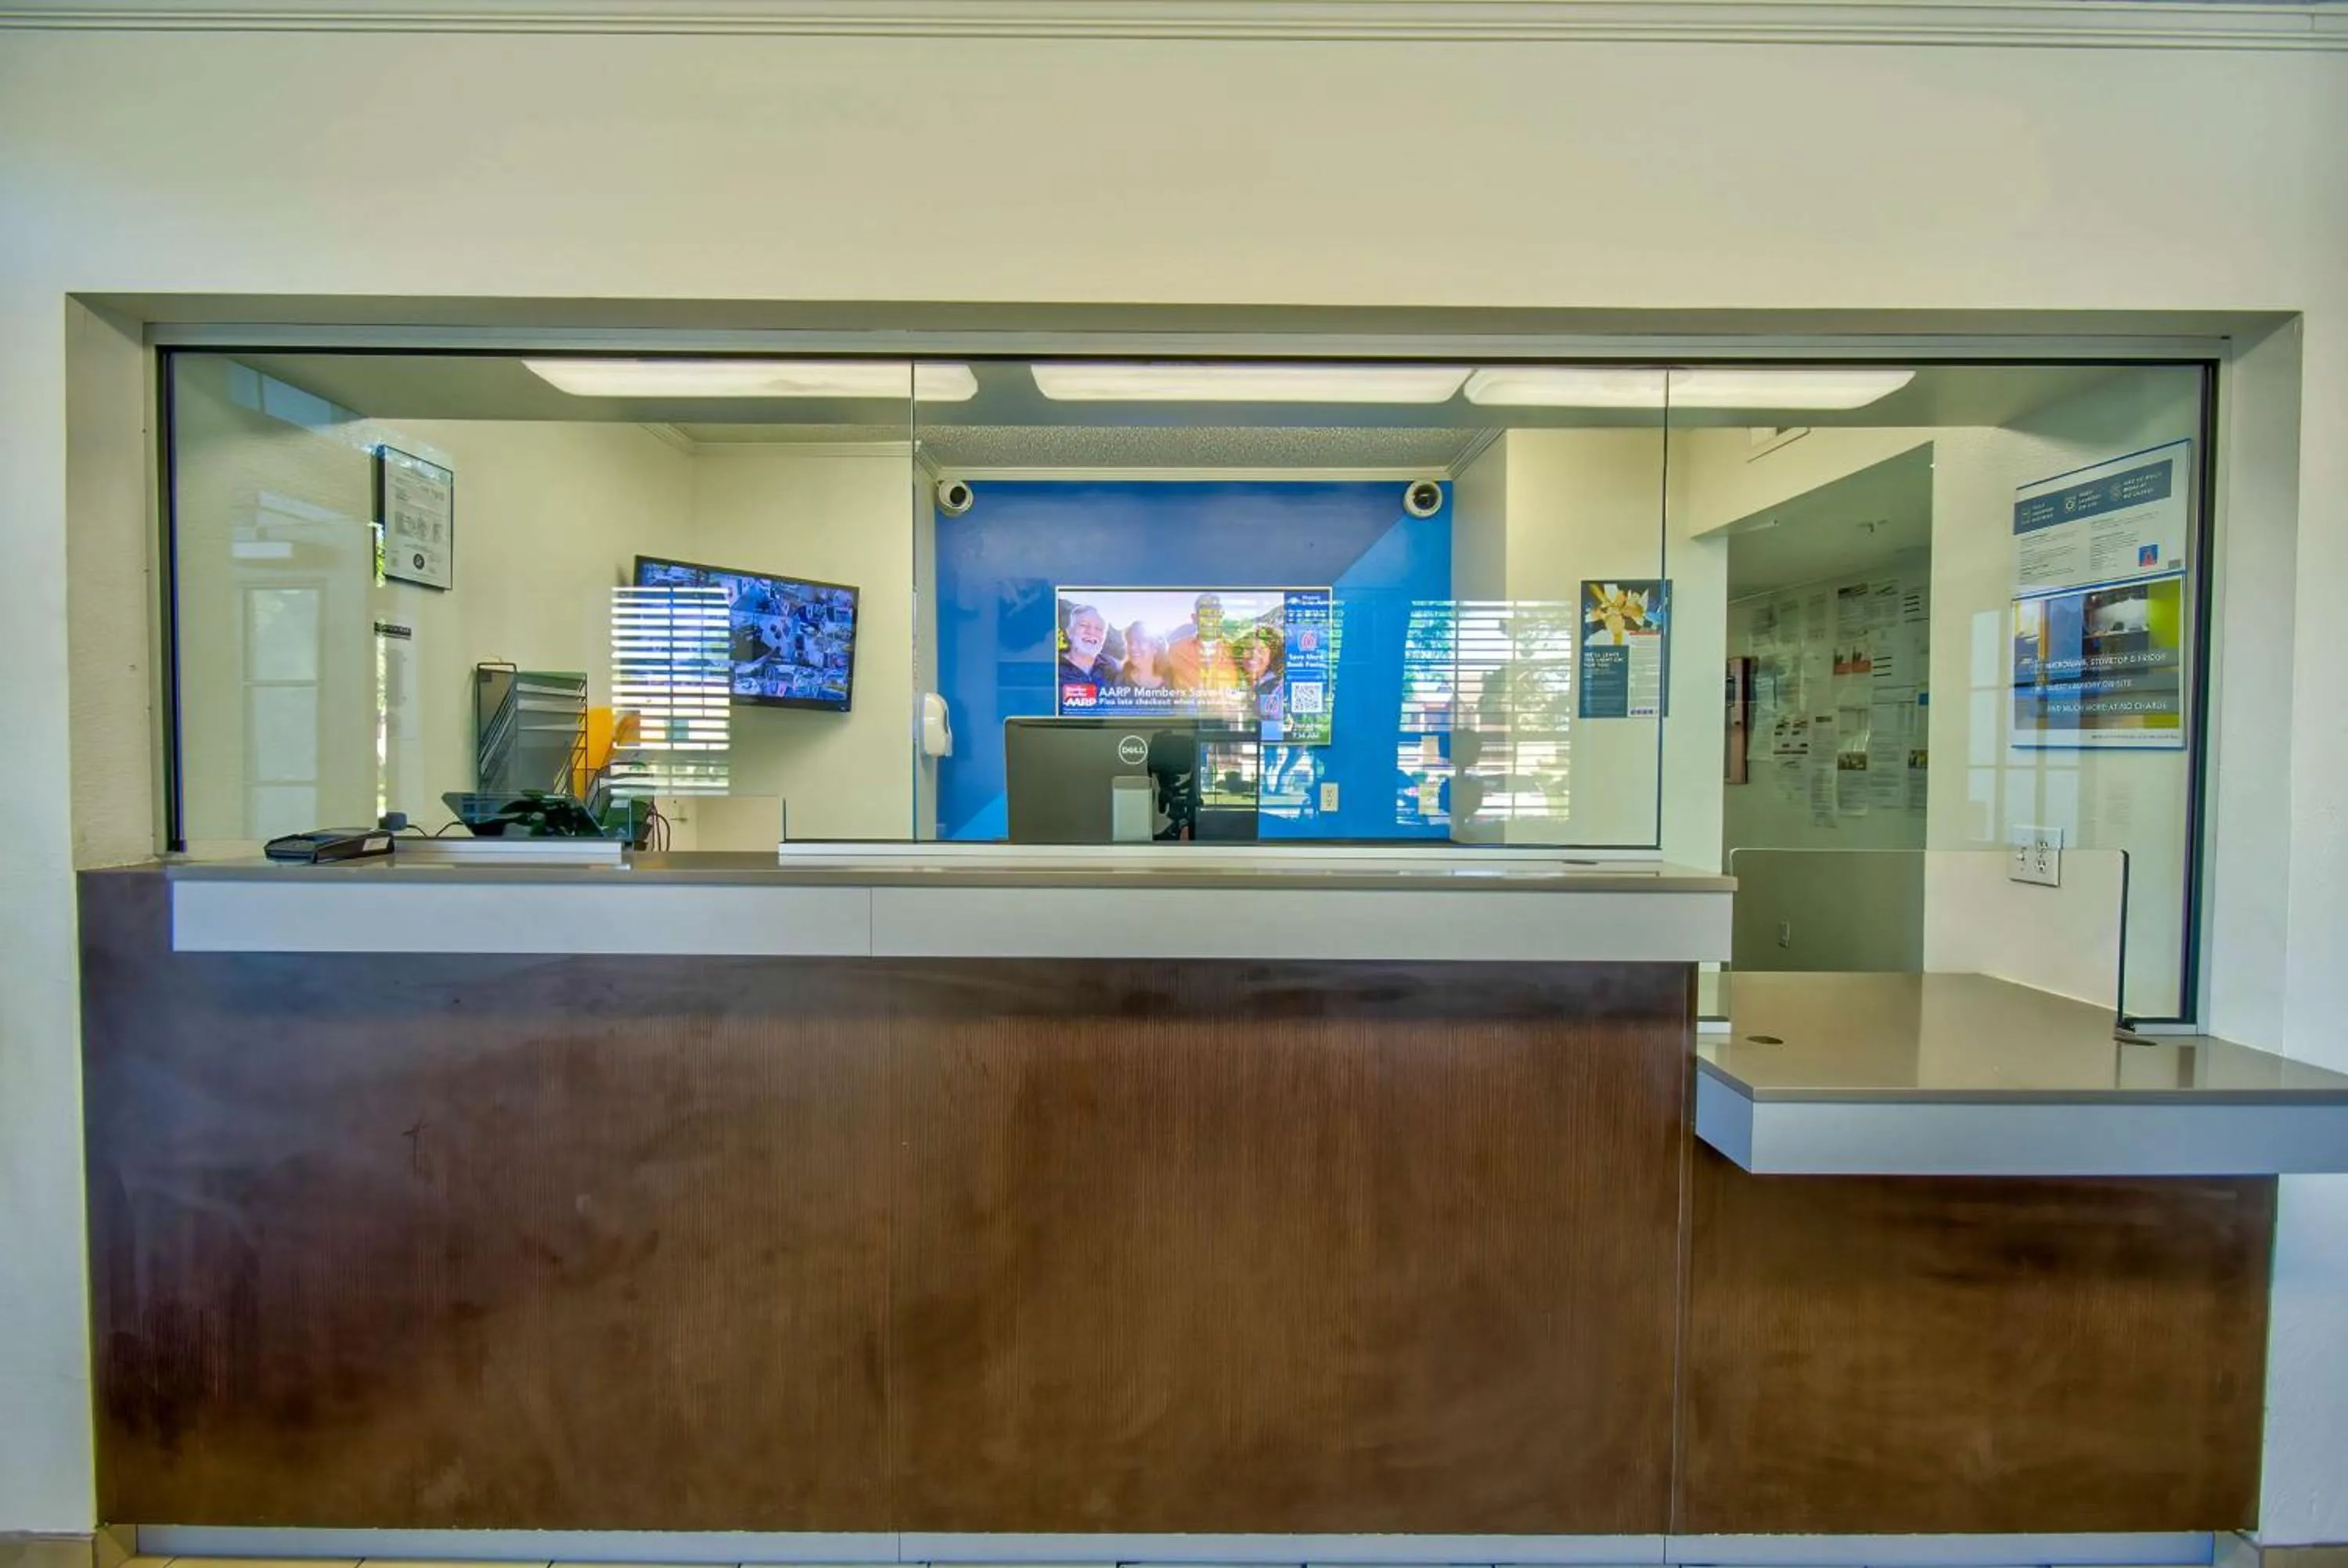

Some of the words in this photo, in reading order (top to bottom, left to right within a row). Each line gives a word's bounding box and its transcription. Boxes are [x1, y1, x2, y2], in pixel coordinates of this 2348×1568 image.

[1098, 686, 1131, 697] AARP
[1133, 685, 1187, 697] Members
[1064, 697, 1097, 707] AARP
